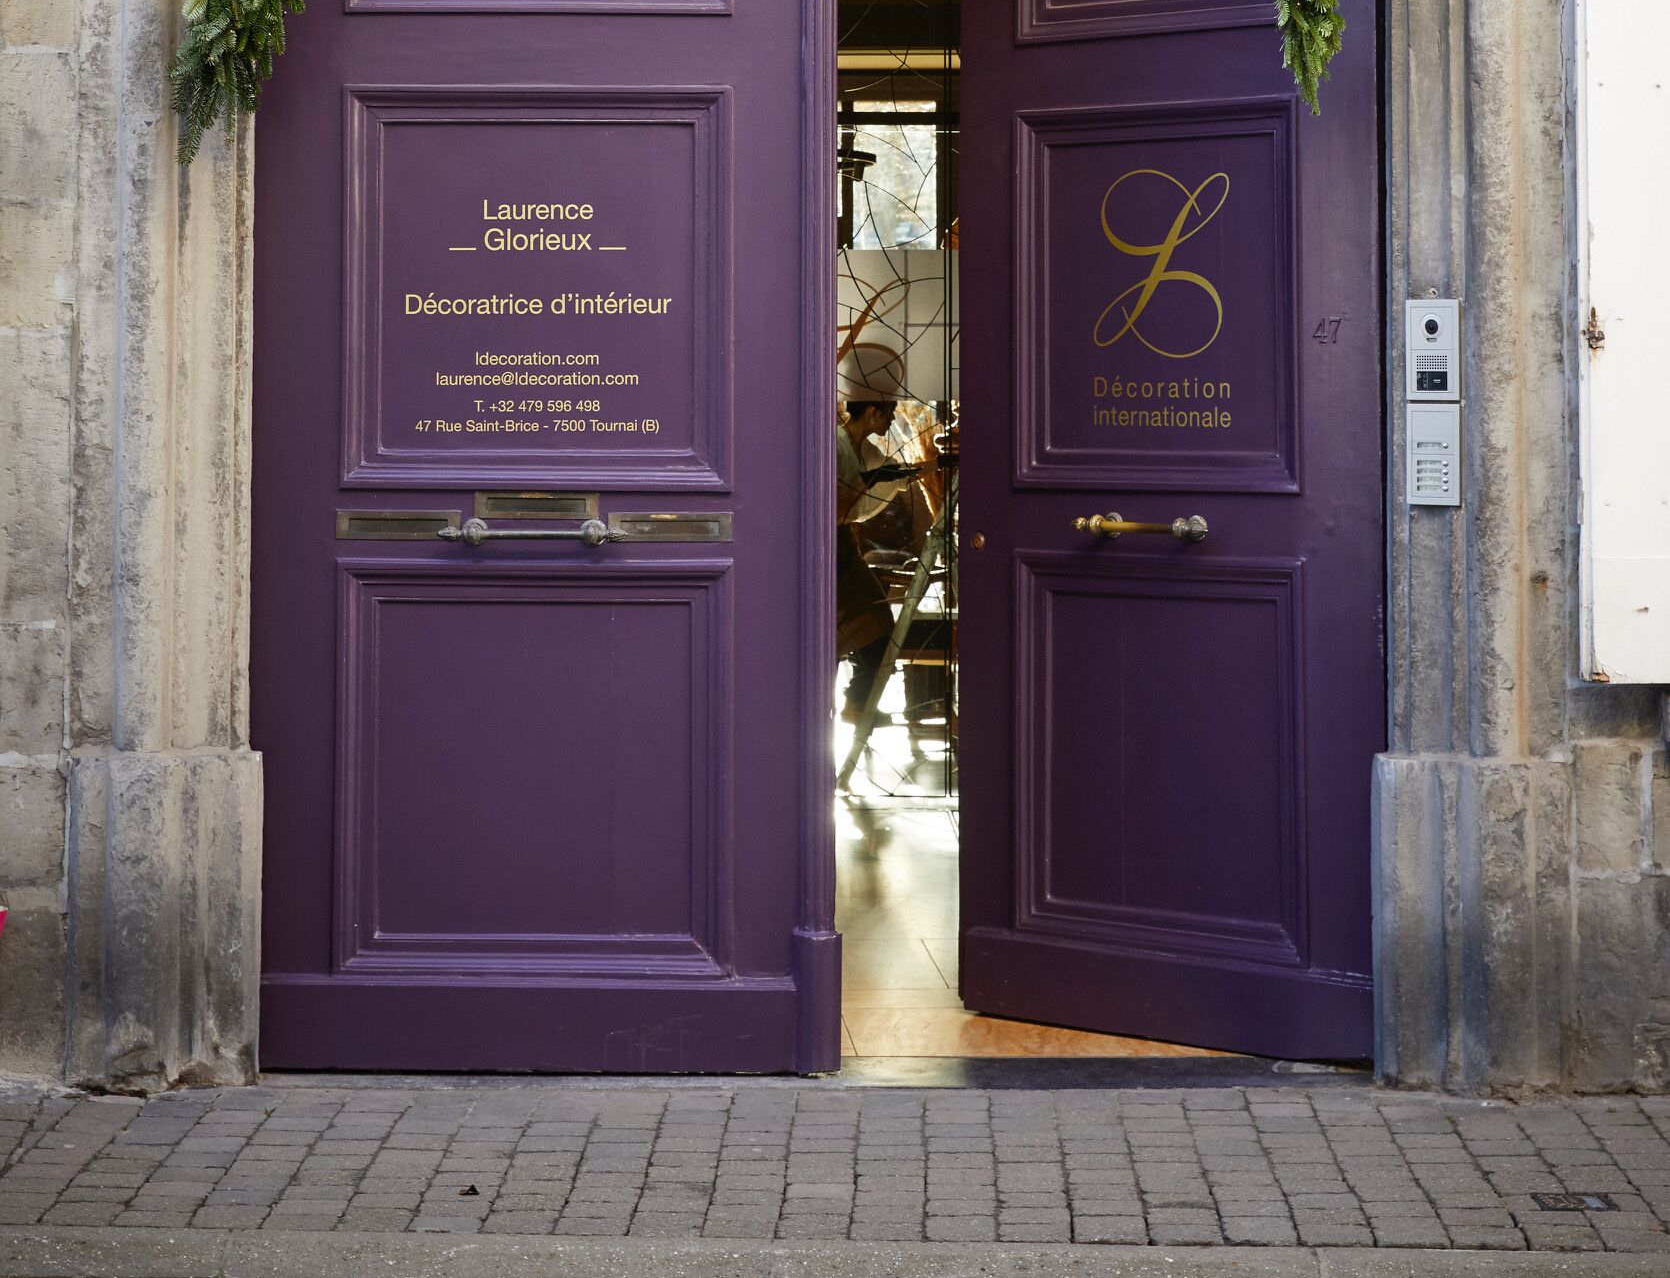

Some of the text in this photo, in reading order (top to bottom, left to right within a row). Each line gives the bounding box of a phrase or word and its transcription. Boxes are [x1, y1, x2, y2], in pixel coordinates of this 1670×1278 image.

[483, 199, 594, 221] Laurence
[484, 227, 592, 251] Glorieux
[405, 292, 544, 315] Décoratrice
[1312, 315, 1342, 344] 47
[475, 351, 600, 366] ldecoration.com
[436, 371, 639, 386] laurence@ldecoration.com
[1094, 375, 1231, 399] Décoration
[474, 400, 601, 412] T. +32 479 596 498
[1093, 405, 1232, 428] internationale
[415, 420, 431, 432] 47
[436, 420, 462, 432] Rue
[465, 419, 539, 433] Saint-Brice
[553, 420, 586, 432] 7500
[590, 419, 638, 432] Tournai
[641, 419, 660, 434] (B)
